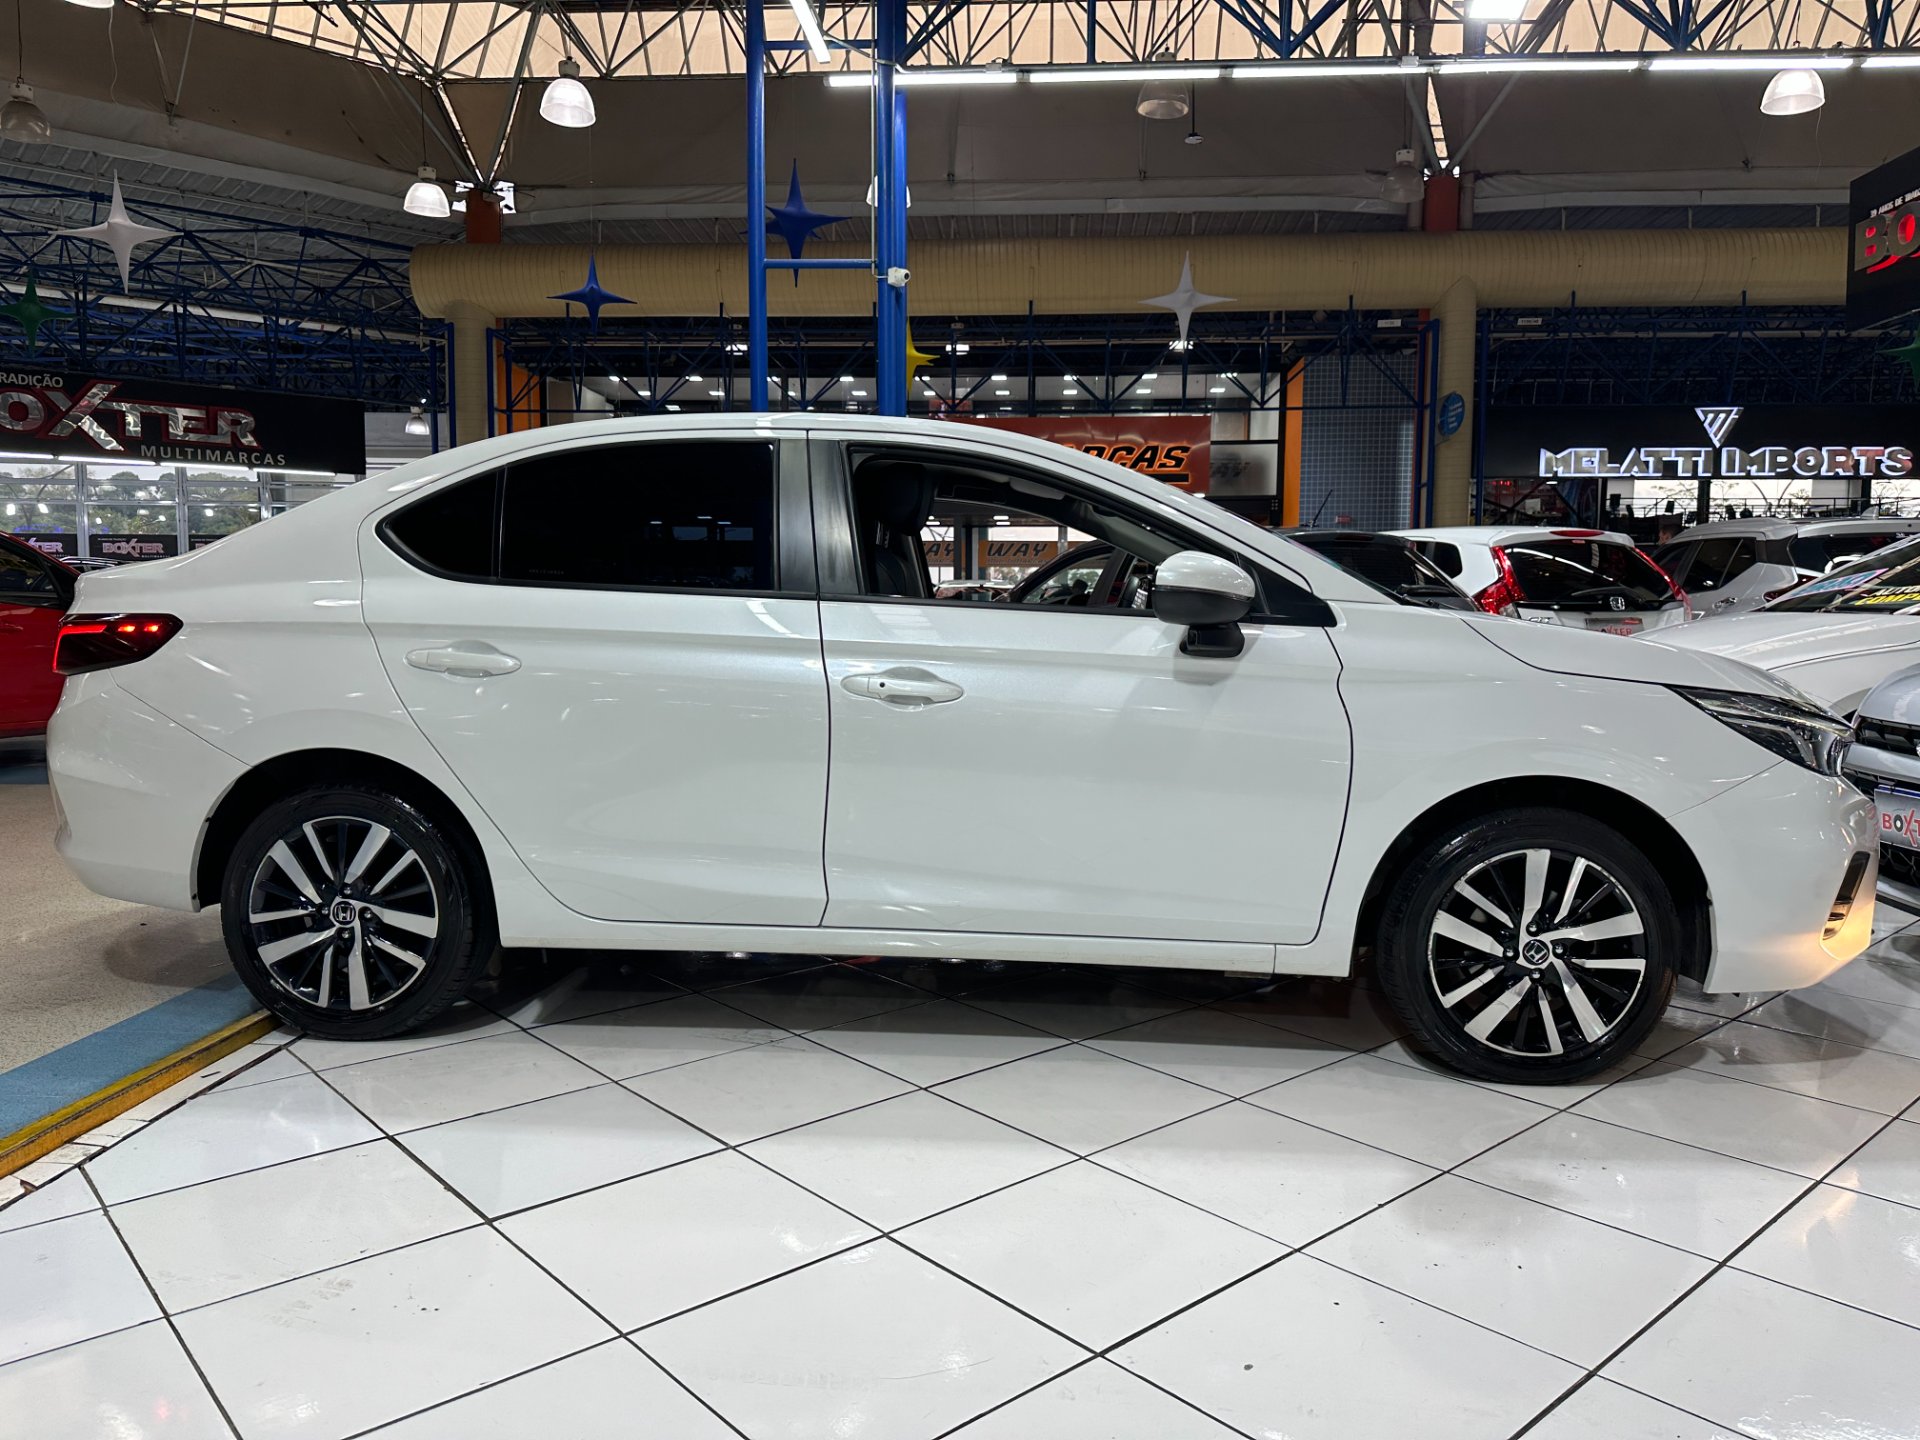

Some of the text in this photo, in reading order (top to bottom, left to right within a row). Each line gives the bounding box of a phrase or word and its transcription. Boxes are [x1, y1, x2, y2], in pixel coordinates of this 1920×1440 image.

[0, 372, 63, 388] RADIÇÃO
[140, 445, 286, 466] MULTIMARCAS
[1539, 446, 1914, 477] MELATTI IMPORTS
[987, 542, 1048, 557] WAY
